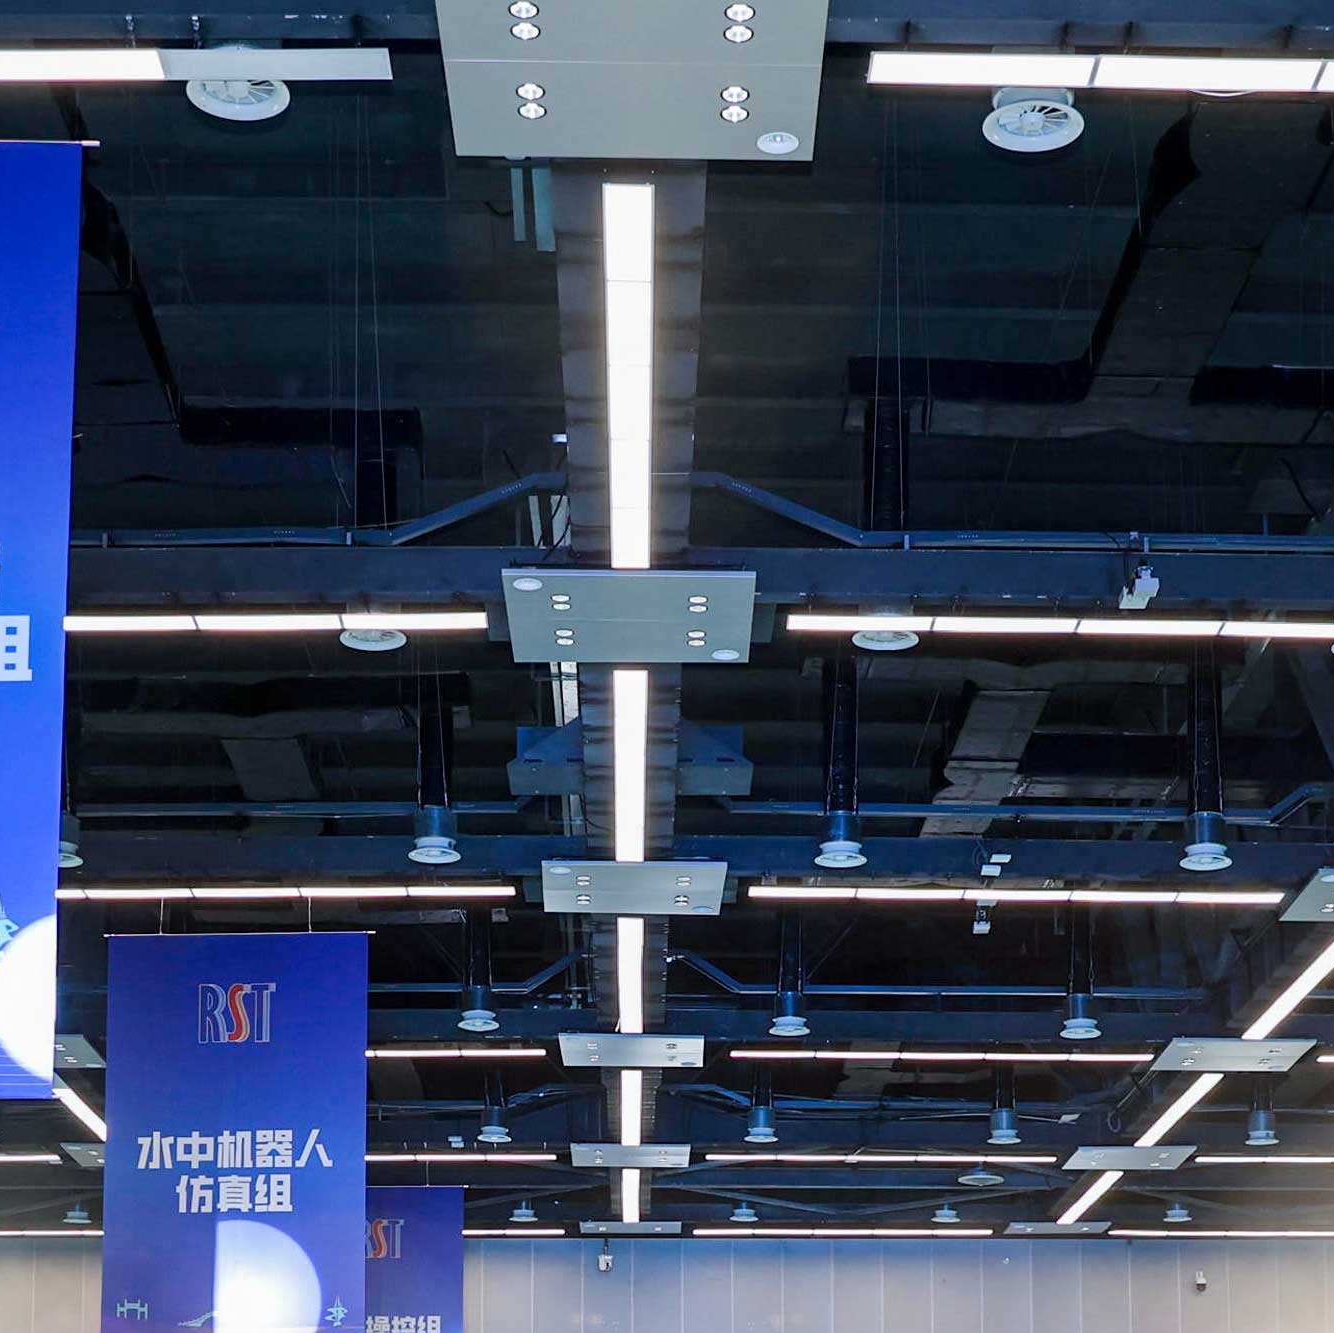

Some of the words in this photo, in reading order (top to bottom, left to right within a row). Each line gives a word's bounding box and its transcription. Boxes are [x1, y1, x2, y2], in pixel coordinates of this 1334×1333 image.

[198, 983, 276, 1044] RST
[137, 1128, 333, 1171] 水中机器人
[175, 1174, 293, 1214] 仿真组
